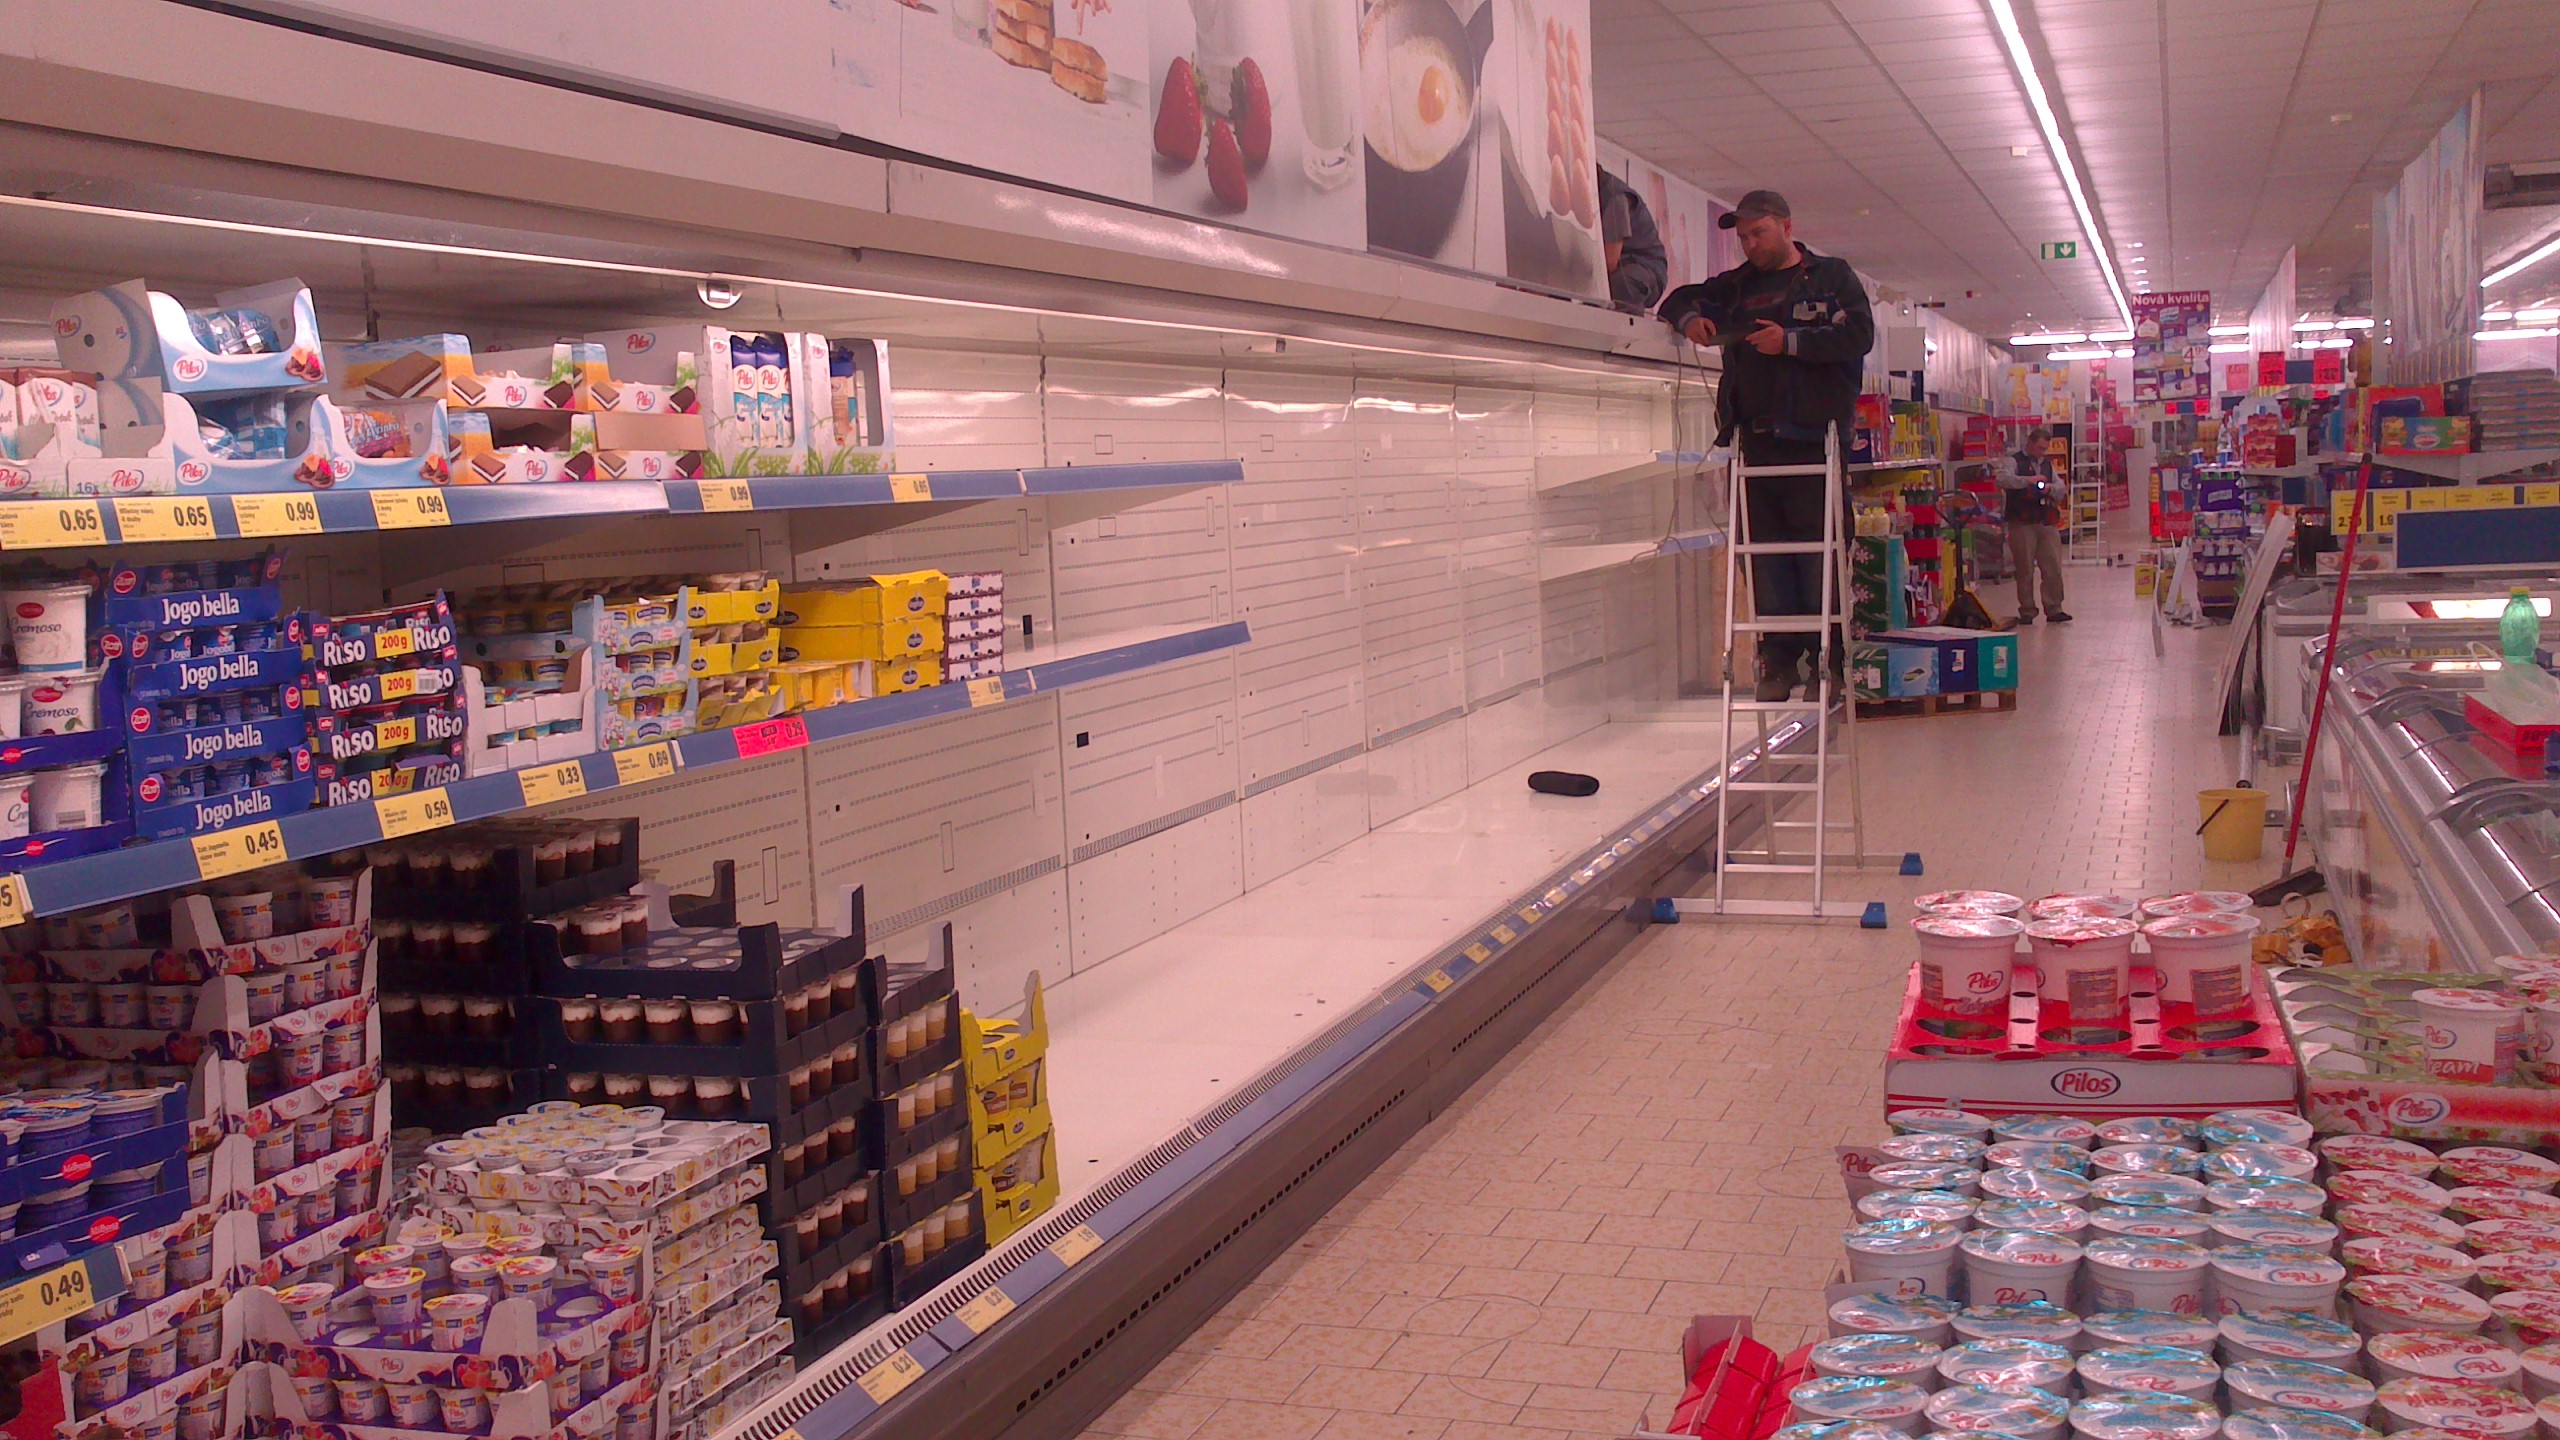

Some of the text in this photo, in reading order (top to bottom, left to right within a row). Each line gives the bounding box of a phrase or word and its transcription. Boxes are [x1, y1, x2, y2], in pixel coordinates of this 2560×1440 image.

[2132, 292, 2209, 306] Nová kvalita
[627, 333, 650, 350] Pilos
[177, 359, 200, 376] Pilos
[737, 369, 753, 386] Pilos
[112, 469, 139, 488] Pilos
[181, 462, 204, 480] Pilos
[729, 486, 749, 500] 0.99
[285, 501, 315, 522] 0.99
[415, 496, 444, 515] 0.99
[59, 509, 98, 532] 0.65
[174, 506, 208, 528] 0.65
[162, 592, 241, 625] Jogo bella
[10, 616, 62, 634] Cremoso
[323, 625, 451, 667] Riso 200 g Riso
[180, 654, 259, 690] Jogo bella
[328, 682, 371, 710] Riso
[387, 676, 404, 691] 200
[405, 678, 412, 690] g
[22, 702, 80, 719] Cremoso
[185, 724, 263, 760] Jogo bella
[331, 713, 463, 760] Riso 200 g Riso
[648, 750, 669, 769] 0.69
[328, 777, 371, 807] Riso
[401, 775, 409, 788] g
[423, 763, 460, 788] Riso
[557, 766, 580, 787] 0.33
[195, 789, 272, 829] Jogo bella
[424, 799, 449, 820] 0.59
[245, 829, 279, 855] 0.45
[1966, 971, 1999, 989] Pilos
[2425, 1025, 2449, 1044] Pilos
[2060, 1071, 2112, 1093] Pilos
[2395, 1097, 2435, 1118] Pilos
[41, 1270, 85, 1306] 0.49
[984, 1289, 1006, 1307] 0.21
[892, 1353, 915, 1374] 0.21
